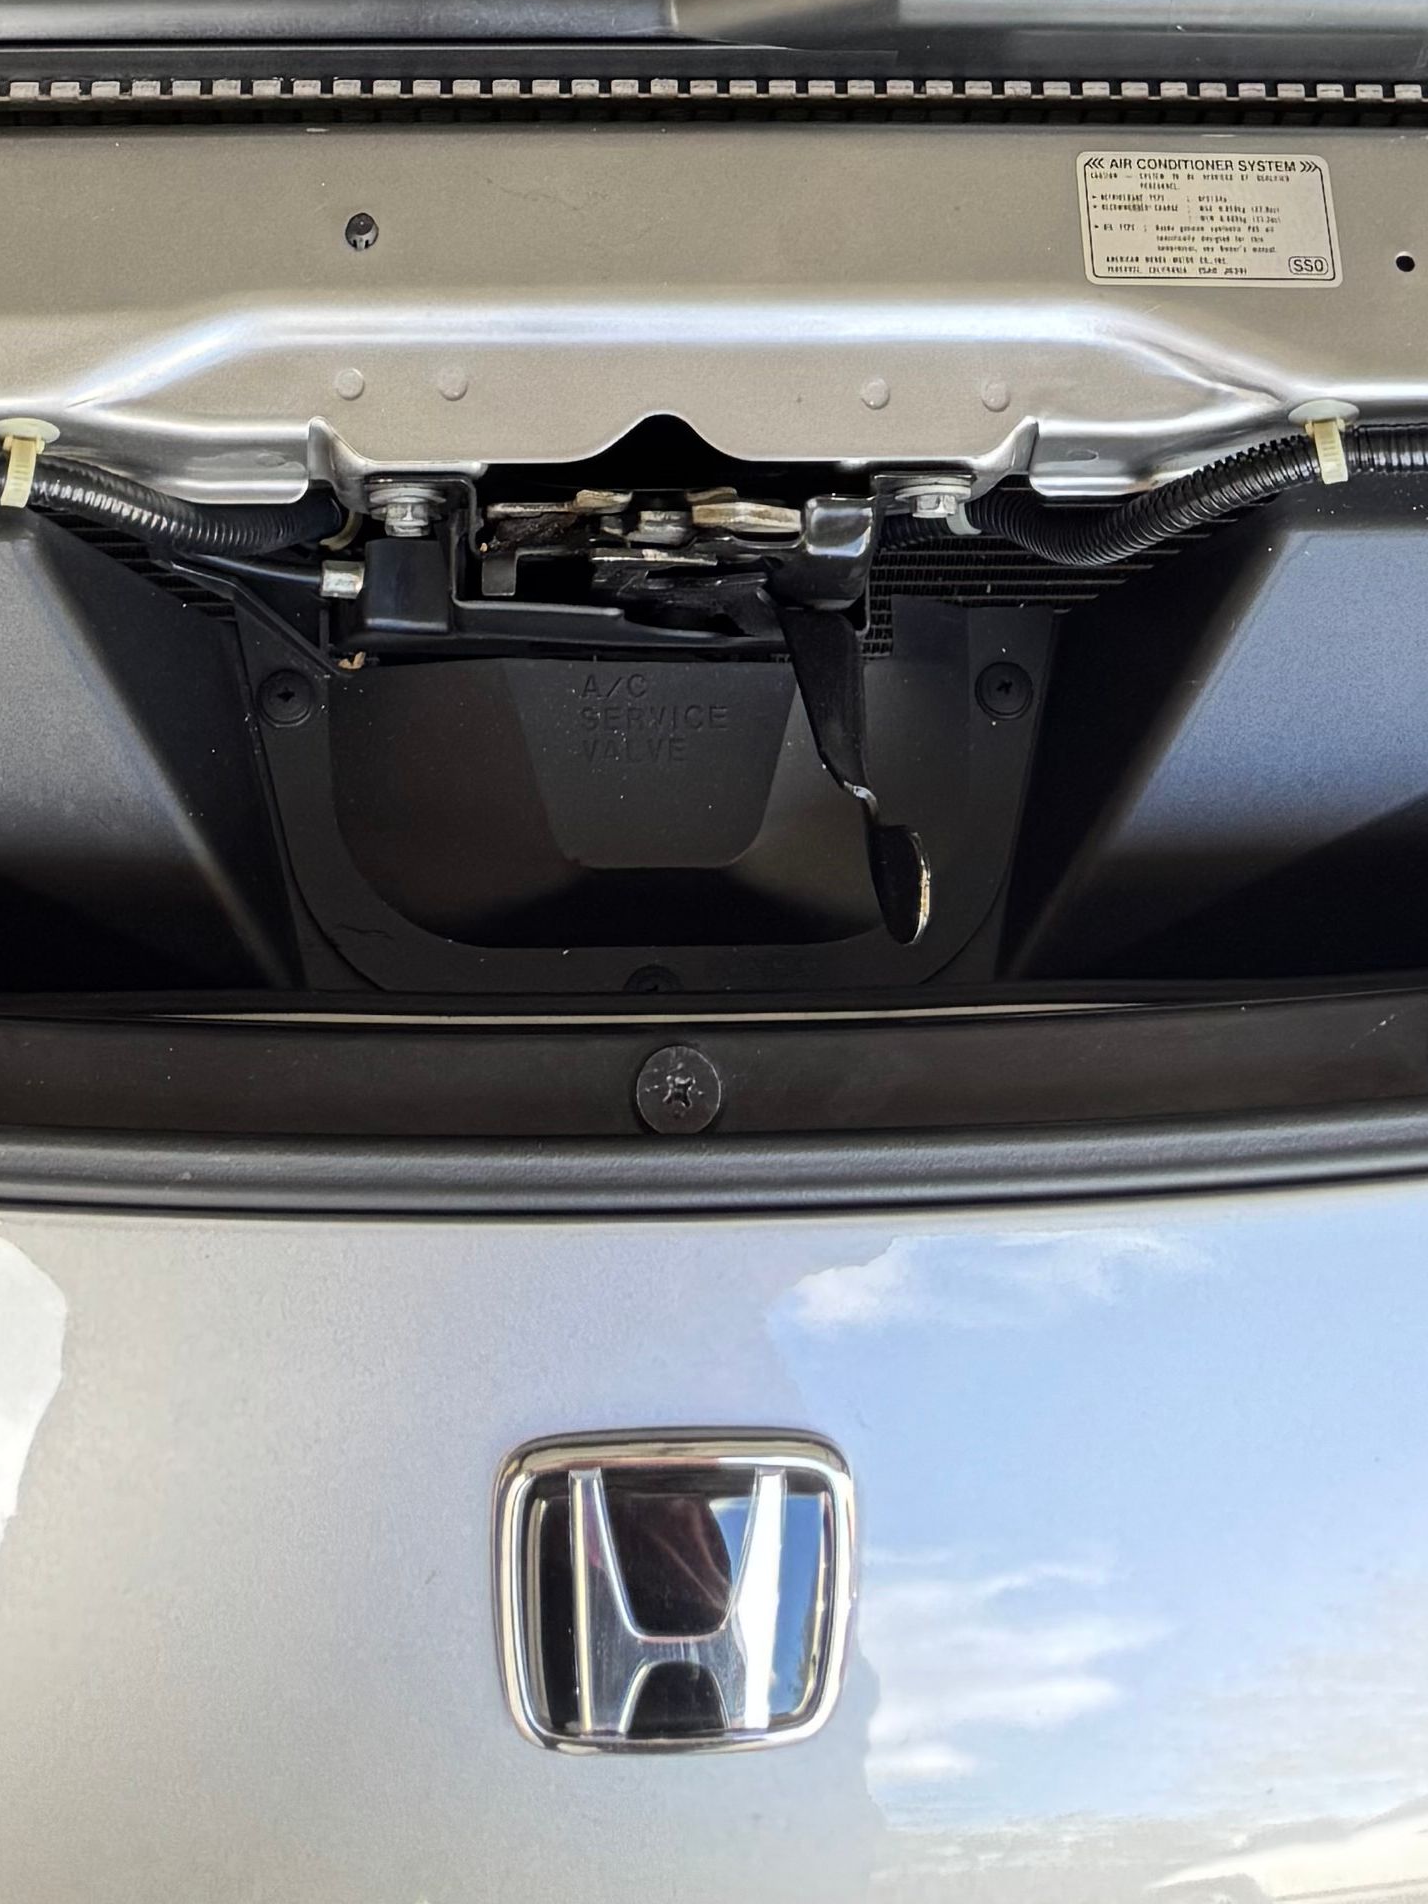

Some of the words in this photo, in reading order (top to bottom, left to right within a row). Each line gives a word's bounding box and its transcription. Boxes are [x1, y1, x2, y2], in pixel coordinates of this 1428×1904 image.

[1109, 158, 1133, 170] AIR
[1136, 159, 1235, 172] CONDITIONER
[1238, 160, 1297, 173] SYSTEM
[581, 673, 647, 698] A/C
[581, 704, 729, 730] SERVICE
[582, 737, 687, 763] VALVE
